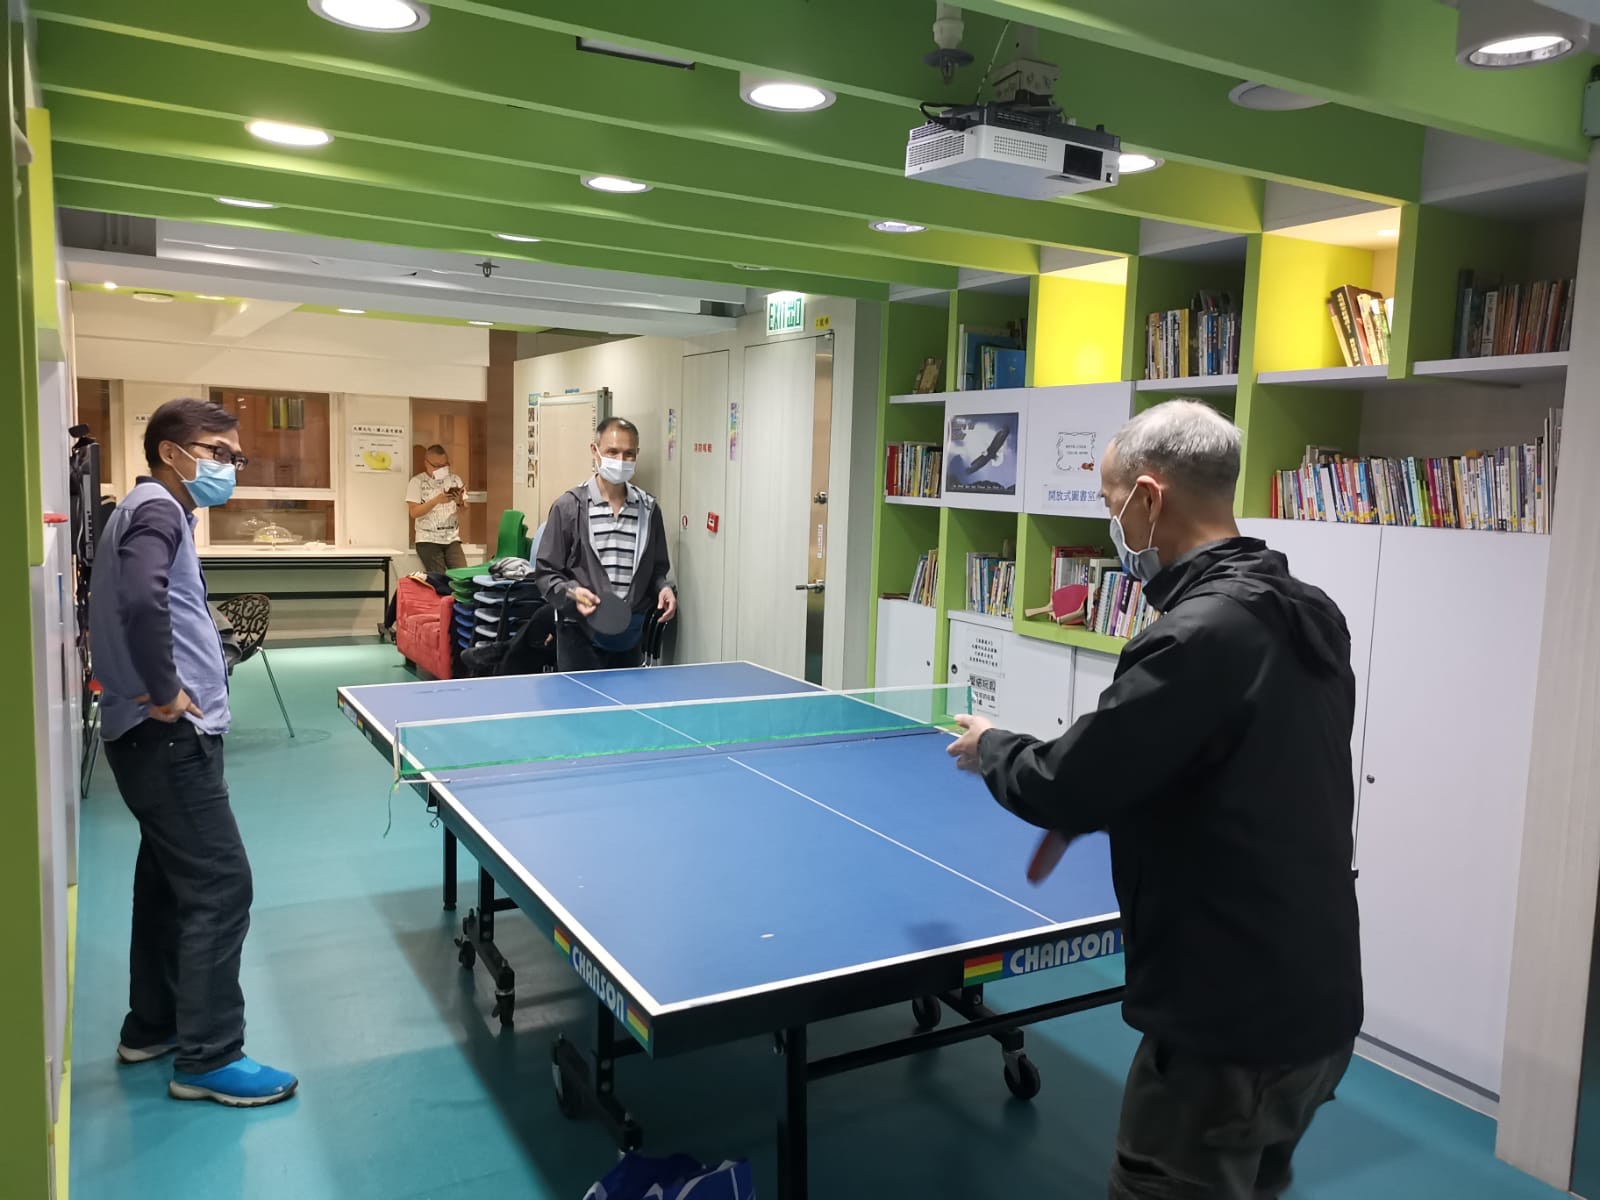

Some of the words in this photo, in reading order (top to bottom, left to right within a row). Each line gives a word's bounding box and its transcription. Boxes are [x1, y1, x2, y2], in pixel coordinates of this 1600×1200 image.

[769, 301, 786, 331] EXIT
[787, 297, 802, 328] 出口
[1009, 930, 1115, 974] CHANSON
[572, 945, 625, 1024] CHANSON
